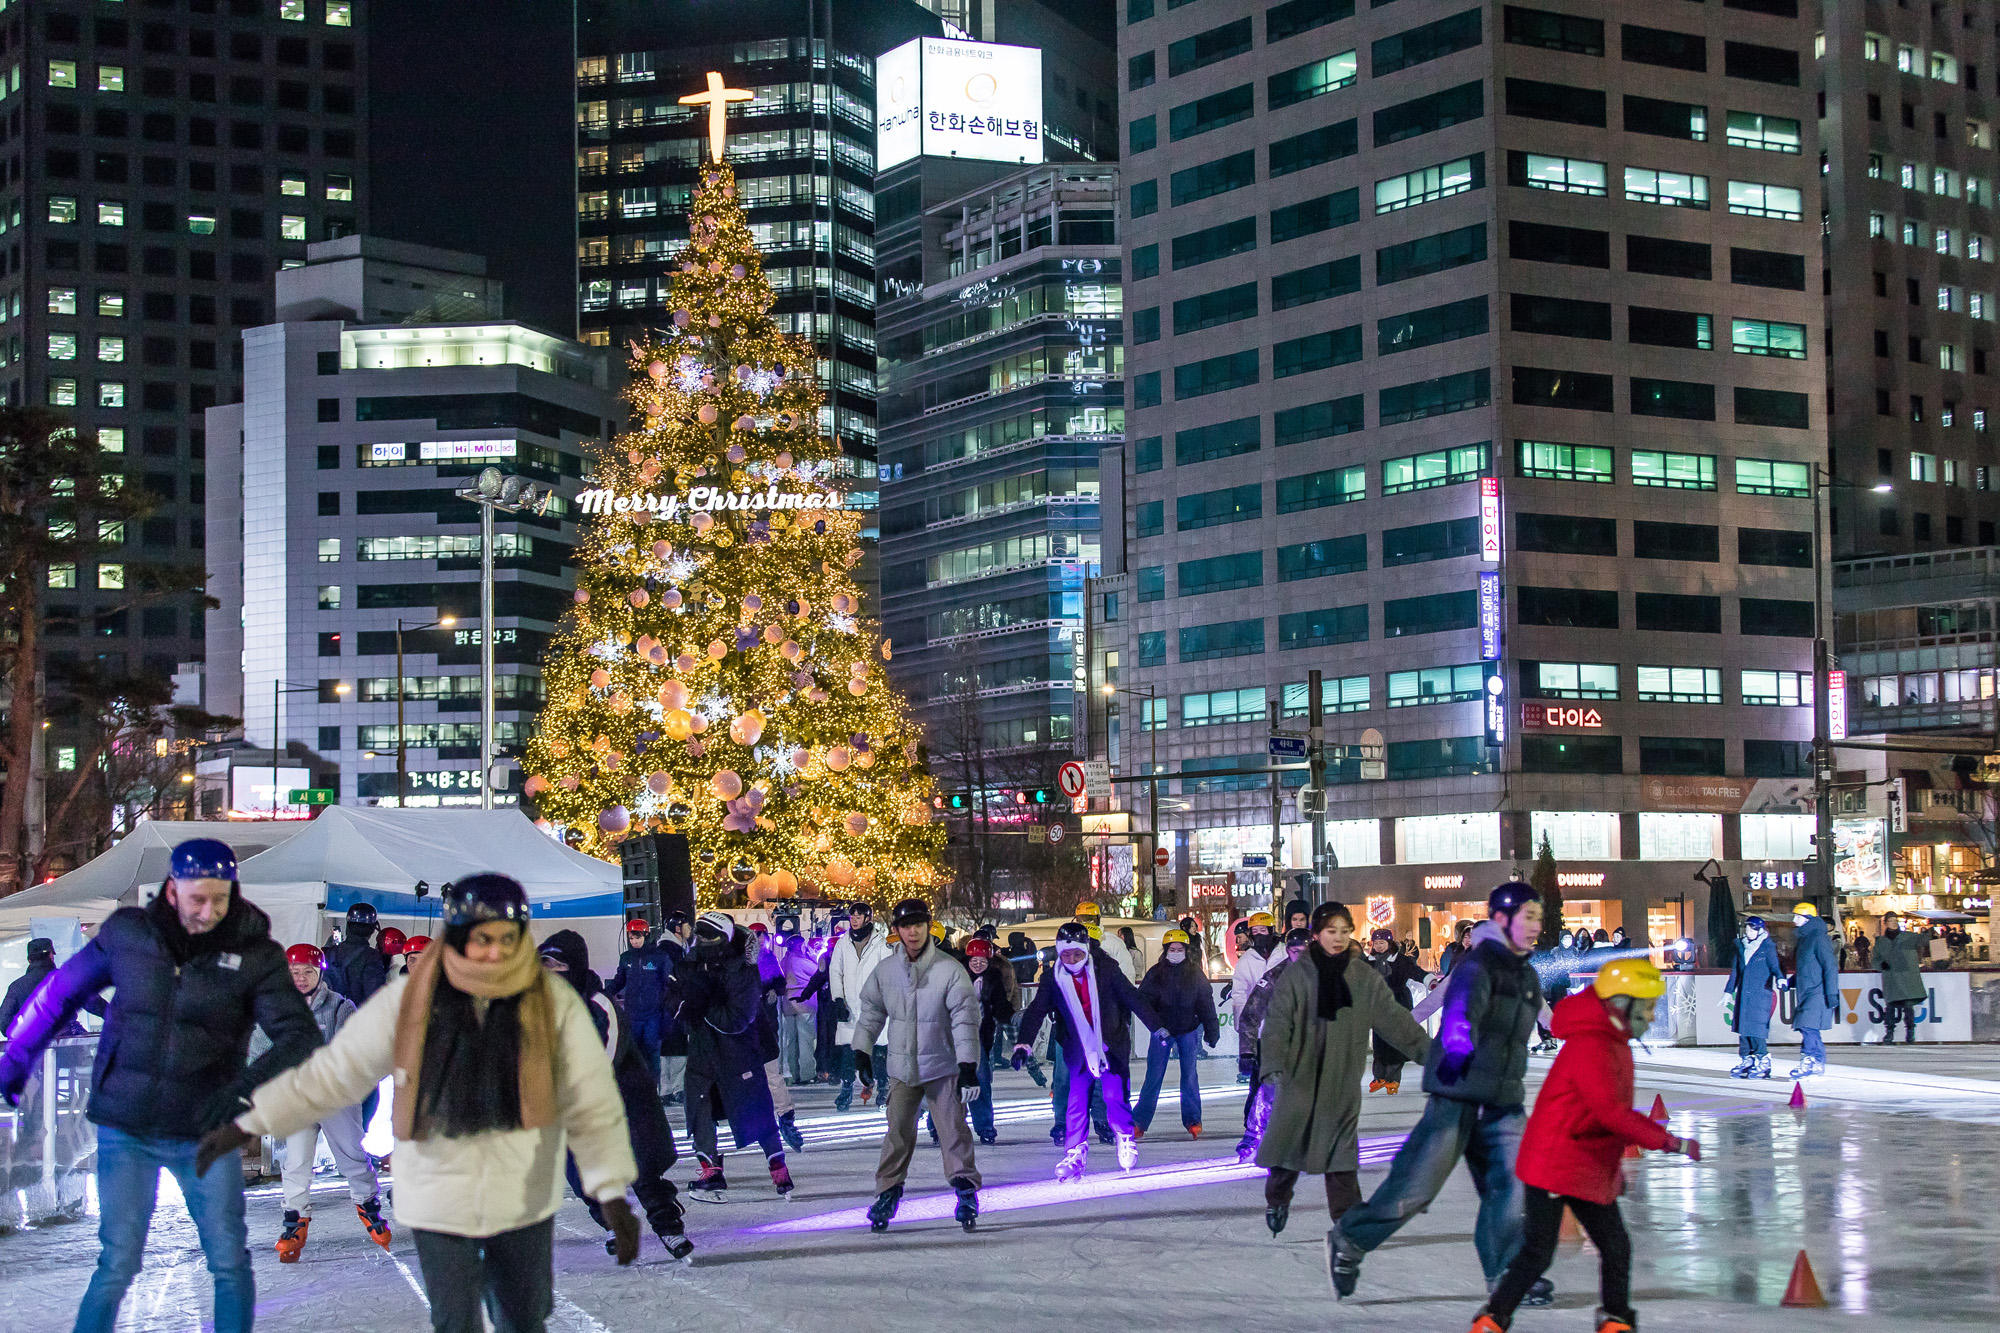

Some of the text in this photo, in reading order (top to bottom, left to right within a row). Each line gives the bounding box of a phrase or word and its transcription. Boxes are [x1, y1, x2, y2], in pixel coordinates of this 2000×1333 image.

[879, 106, 920, 135] Hanwha
[928, 110, 1038, 140] 한화손해보험
[575, 485, 845, 520] Merry Christmas
[1483, 506, 1498, 551] 다이소
[1481, 579, 1495, 658] 경동대학교
[1546, 707, 1602, 728] 다이소
[1831, 694, 1843, 735] 다이소
[408, 770, 482, 789] 7:48:26
[1665, 785, 1741, 798] GLOBAL TAX FREE
[1051, 827, 1062, 839] 50
[1201, 884, 1226, 896] 다이소
[1231, 882, 1272, 897] 경동대학교
[1424, 875, 1464, 889] DUNKIN'
[1557, 873, 1606, 887] DUNKIN'
